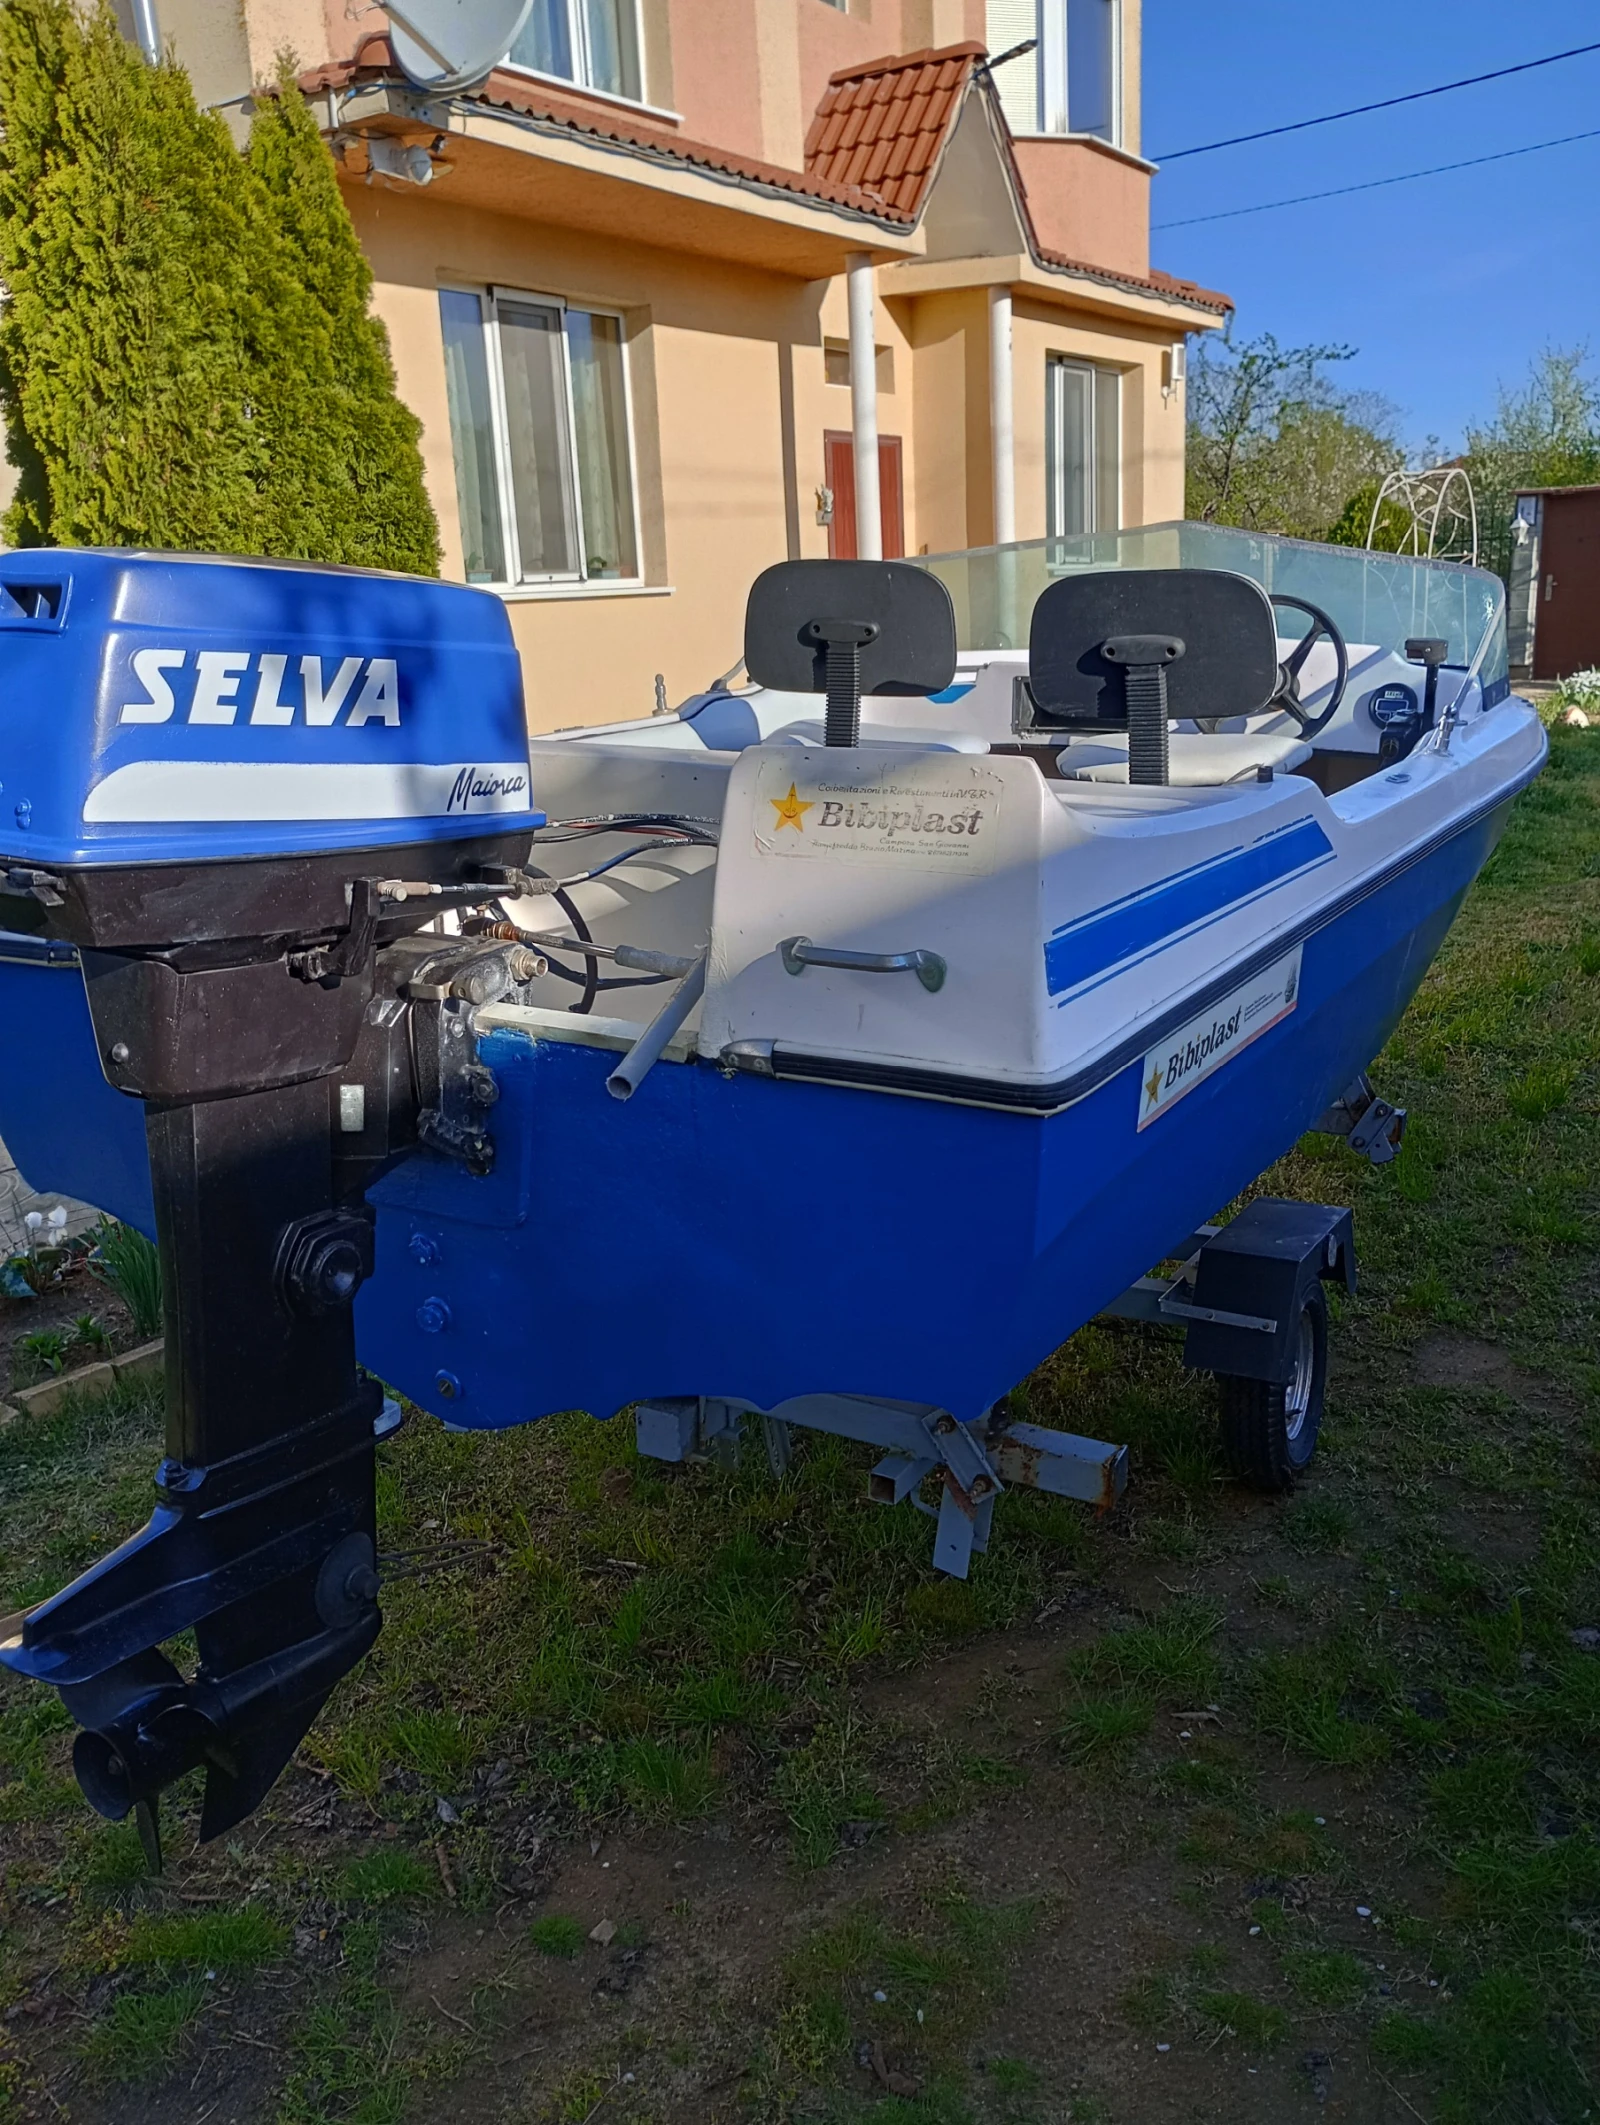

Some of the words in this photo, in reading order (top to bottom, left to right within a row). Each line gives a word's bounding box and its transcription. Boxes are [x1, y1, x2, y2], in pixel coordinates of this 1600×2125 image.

[120, 647, 401, 727] SELVA
[446, 767, 527, 813] Maiorca
[818, 801, 985, 837] Bibiplast
[879, 837, 915, 846] Campora
[918, 839, 934, 847] San
[935, 840, 970, 848] Giovanni
[1164, 1004, 1242, 1089] Bibiplast
